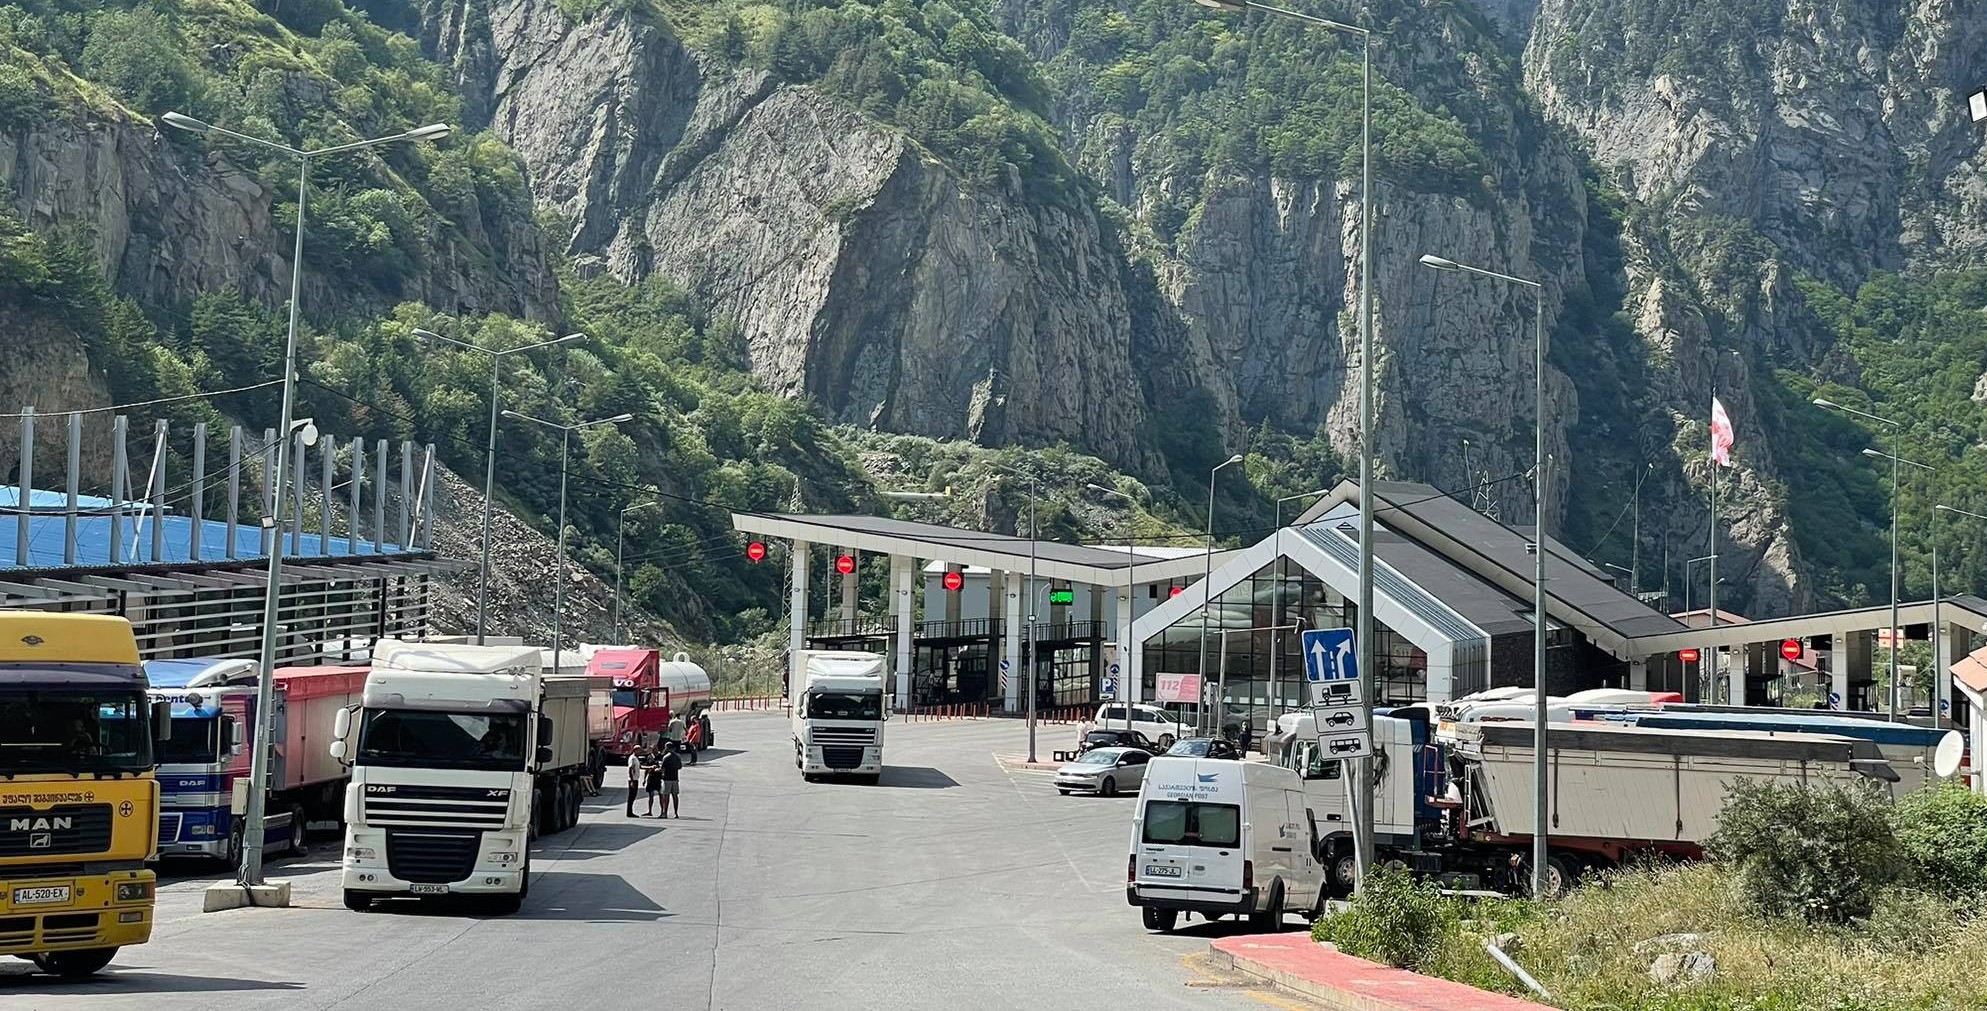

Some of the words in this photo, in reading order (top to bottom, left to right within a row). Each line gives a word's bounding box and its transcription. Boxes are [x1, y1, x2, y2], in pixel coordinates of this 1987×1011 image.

[1160, 680, 1180, 690] 112
[10, 817, 72, 831] MAN
[22, 889, 63, 899] AL-520-EX
